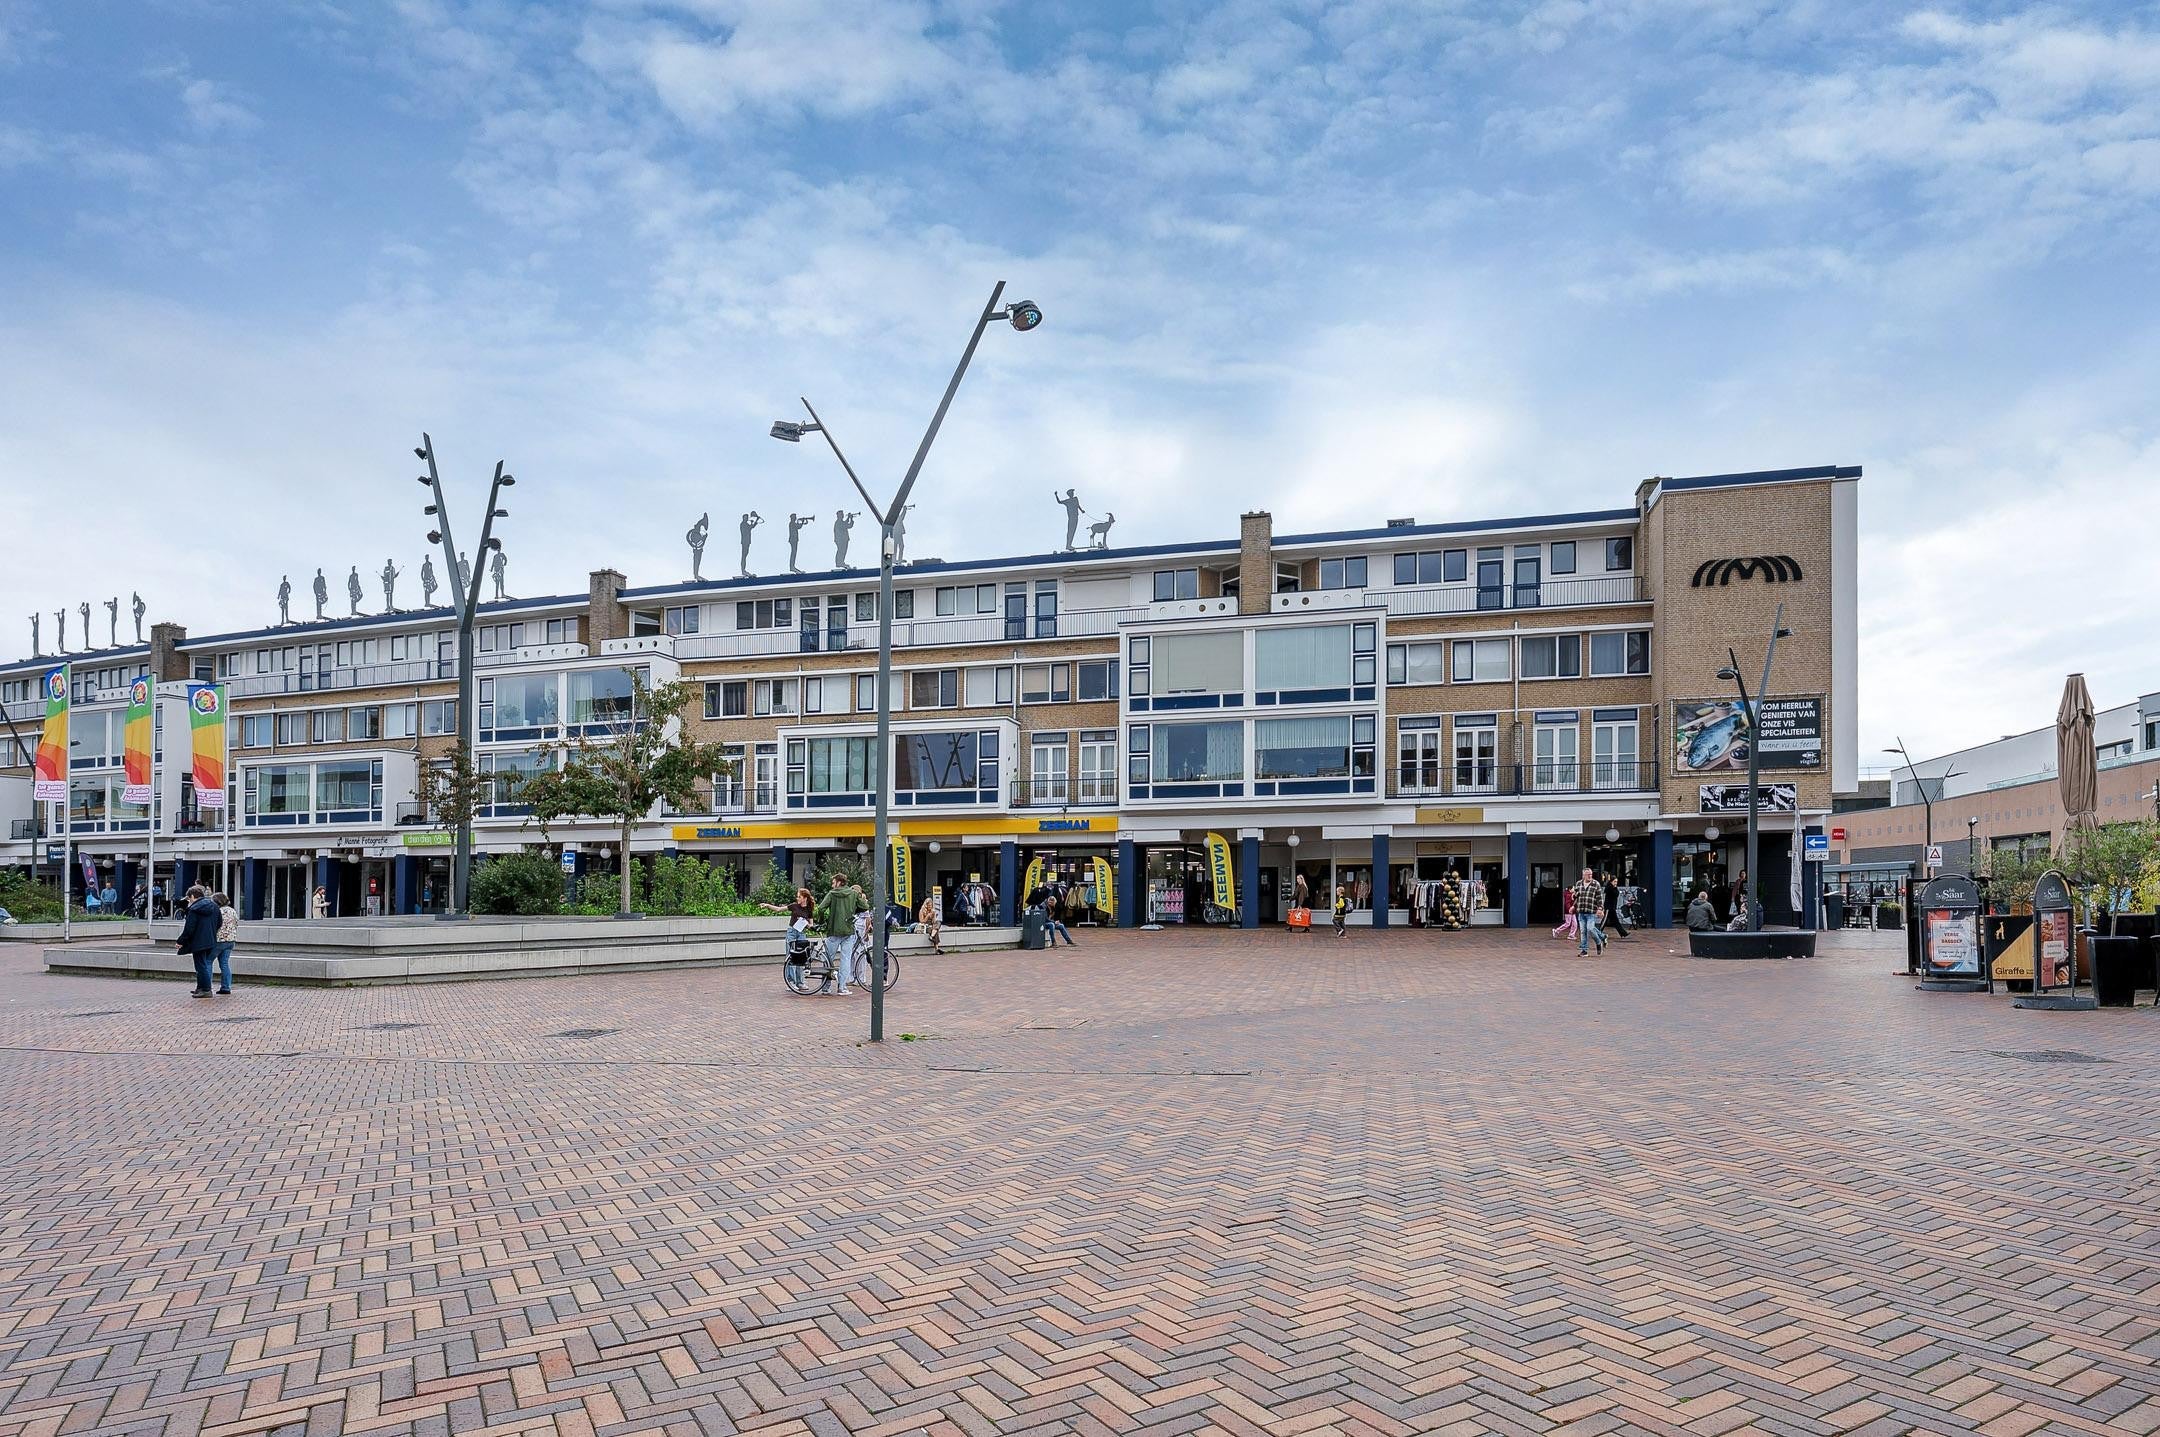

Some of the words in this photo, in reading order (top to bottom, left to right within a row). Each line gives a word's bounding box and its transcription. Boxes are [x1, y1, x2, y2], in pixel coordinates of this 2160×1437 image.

[1781, 701, 1813, 710] HEERLIJK
[1761, 711, 1796, 719] GENIETEN
[1798, 710, 1815, 718] VAN
[1761, 728, 1815, 737] SPECIALITEITEN
[1039, 820, 1090, 831] ZEEMAN
[697, 828, 741, 838] ZEEMAN
[1942, 889, 1965, 899] Saar
[1995, 967, 2025, 975] Giraffe
